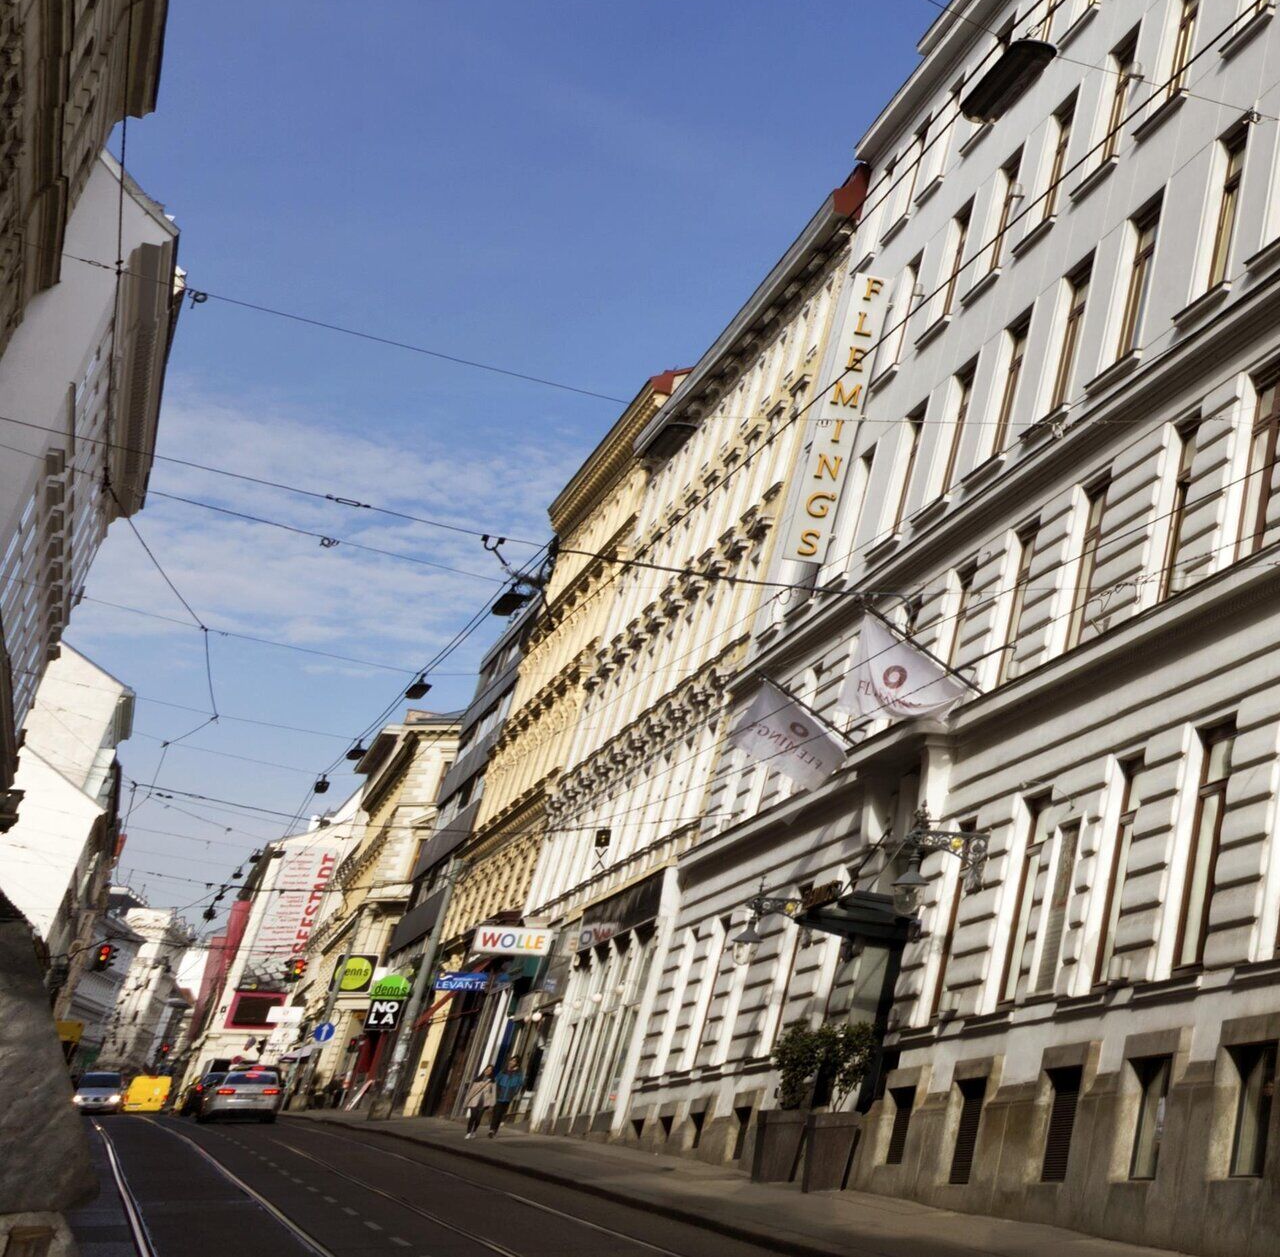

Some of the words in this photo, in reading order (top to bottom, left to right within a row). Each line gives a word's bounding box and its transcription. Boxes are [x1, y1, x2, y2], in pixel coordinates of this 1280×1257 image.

[482, 931, 546, 950] WOLLE
[435, 980, 487, 990] LEVANTE
[372, 1001, 400, 1013] NO
[368, 1013, 395, 1025] LA
